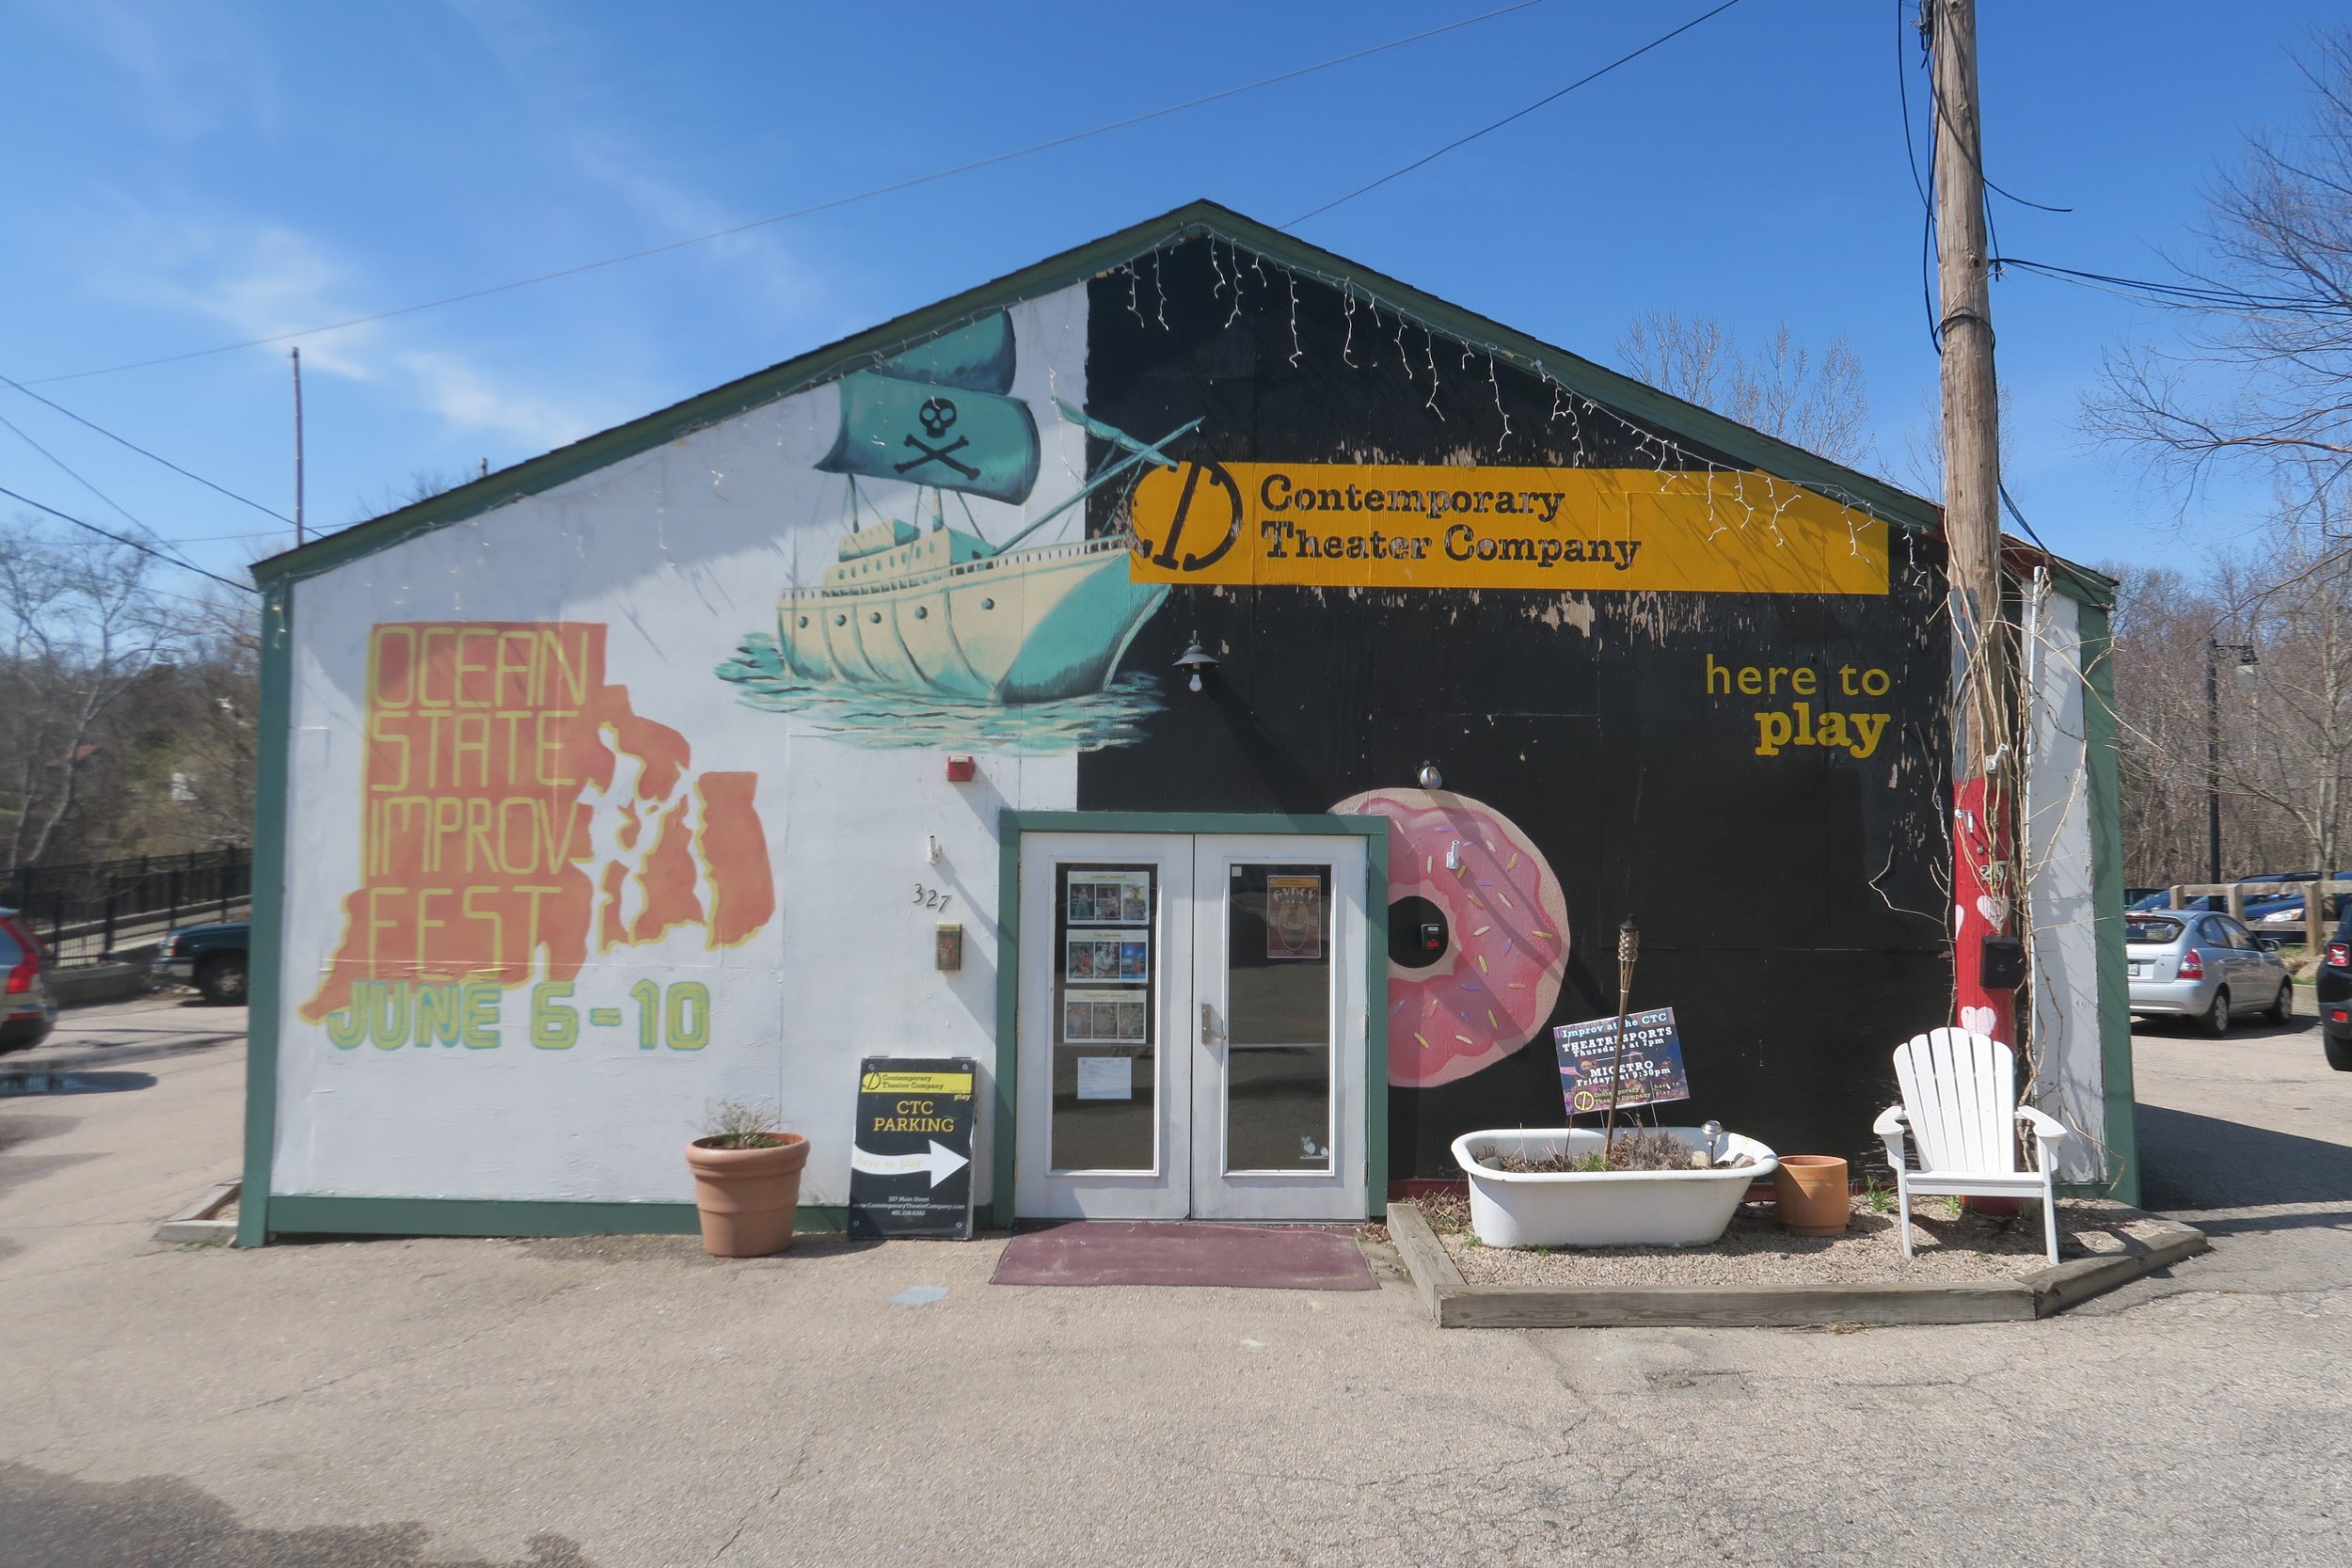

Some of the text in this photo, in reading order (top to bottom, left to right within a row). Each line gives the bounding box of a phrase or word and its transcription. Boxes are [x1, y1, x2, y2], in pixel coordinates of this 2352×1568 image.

[1261, 473, 1565, 523] Contemporary
[1261, 521, 1643, 572] Theater Company
[375, 626, 589, 709] OCEAN
[1707, 653, 1891, 697] here to
[1755, 702, 1891, 759] play
[370, 710, 580, 792] STATE
[369, 796, 578, 878] IMPROV
[913, 882, 952, 913] 327
[368, 885, 563, 982] FEST
[326, 978, 502, 1052] JUNE
[1563, 1013, 1667, 1039] Improv at he CTC
[1572, 1044, 1627, 1058] Thursdas
[1643, 1038, 1664, 1048] 7pm
[882, 1073, 932, 1083] Contemporary
[912, 1082, 944, 1090] Company
[1576, 1068, 1671, 1087] Friday at 9:30pm
[1593, 1086, 1641, 1099] Conteporary
[896, 1101, 934, 1116] CTC
[1594, 1089, 1671, 1105] Thear Company play
[872, 1117, 955, 1133] PARKING
